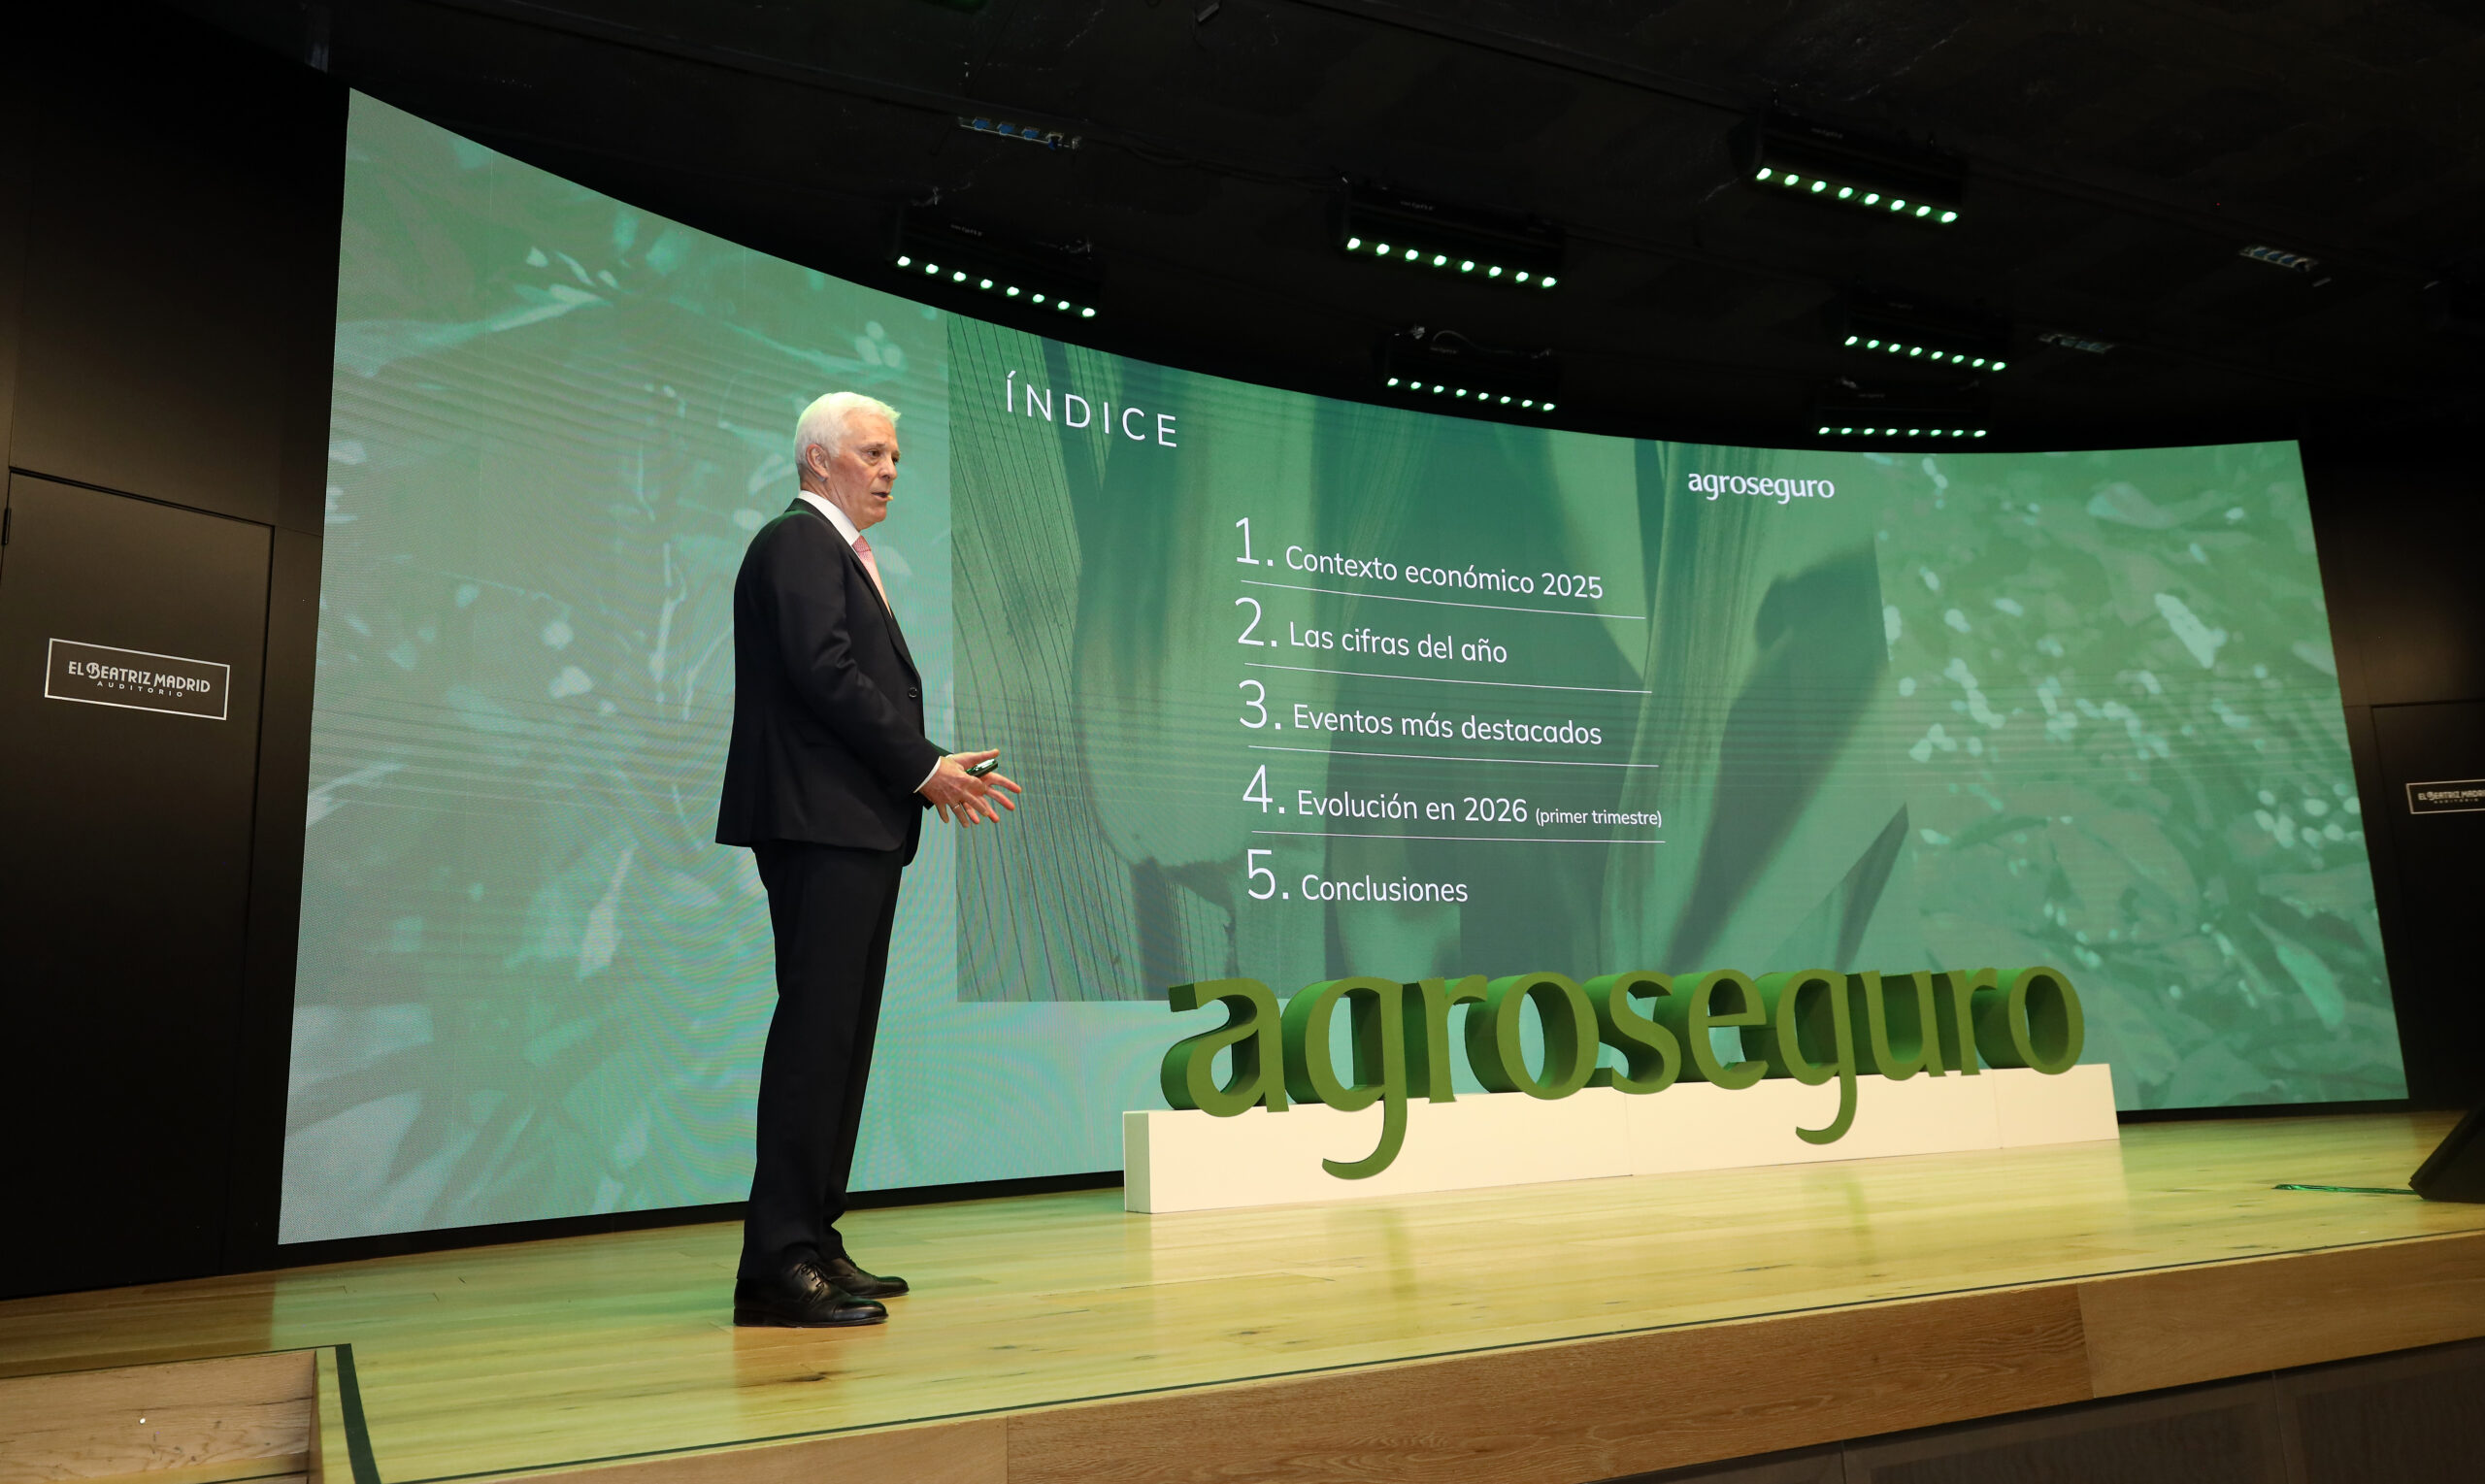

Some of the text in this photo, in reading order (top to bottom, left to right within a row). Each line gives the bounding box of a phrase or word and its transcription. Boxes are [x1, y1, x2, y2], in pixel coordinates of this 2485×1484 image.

[1007, 370, 1177, 447] ÍNDICE
[1687, 473, 1836, 505] agroseguro
[1235, 516, 1604, 600] 1. Contexto económico 2025
[1235, 597, 1508, 664] 2. Las cifras del año
[68, 661, 211, 693] EL BEATRIZ MADRID
[97, 680, 183, 698] AUDITORIO
[1238, 678, 1604, 745] 3. Eventos más destacados
[1242, 764, 1663, 828] 4. Evolución en 2026 (primer trimestre)
[1247, 848, 1469, 903] 5. Conclusiones
[1160, 966, 2085, 1180] agroseguro
